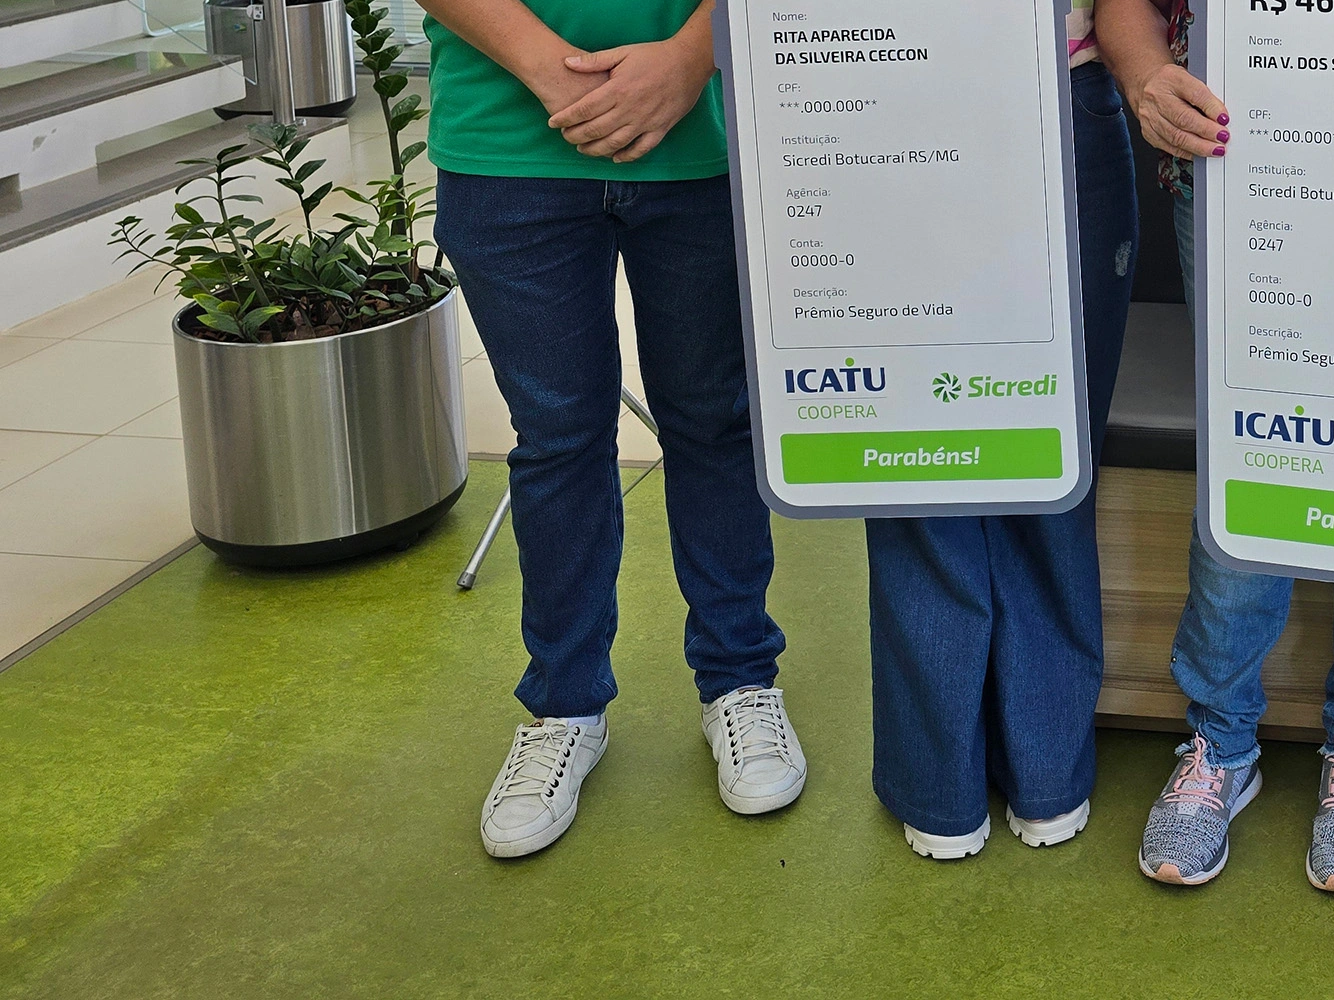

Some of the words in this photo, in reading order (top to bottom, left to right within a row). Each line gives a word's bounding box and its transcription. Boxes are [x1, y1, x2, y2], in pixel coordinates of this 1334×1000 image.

[772, 12, 807, 22] Nome:
[773, 31, 808, 44] RITA
[810, 28, 896, 43] APARECIDA
[1249, 35, 1282, 46] Nome:
[775, 52, 797, 65] DA
[799, 50, 866, 64] SILVEIRA
[869, 48, 928, 62] CECCON
[1248, 55, 1278, 69] IRIA
[1280, 56, 1294, 69] V.
[1297, 57, 1328, 71] DOS
[777, 83, 801, 93] CPF:
[1249, 109, 1271, 120] CPF:
[781, 134, 841, 146] Instituição:
[783, 153, 831, 167] Sicredi
[835, 151, 905, 166] Botucaraí
[908, 149, 960, 164] RS/MG
[1248, 164, 1306, 178] Instituição:
[786, 188, 831, 199] Agência:
[1248, 183, 1296, 199] Sicredi
[786, 204, 823, 218] 0247
[1249, 219, 1293, 231] Agência:
[789, 239, 824, 248] Conta:
[1249, 237, 1284, 251] 0247
[791, 253, 855, 268] 00000-0
[1249, 273, 1282, 284] Conta:
[793, 287, 848, 299] Descrição:
[1249, 290, 1312, 307] 00000-0
[794, 306, 845, 319] Prêmio
[848, 305, 898, 320] Seguro
[902, 304, 919, 316] de
[922, 303, 953, 316] Vida
[1249, 326, 1302, 340] Descrição:
[1249, 345, 1298, 362] Prêmio
[784, 357, 886, 394] ICATU
[967, 374, 1057, 398] Sicredi
[797, 404, 878, 420] COOPERA
[1234, 405, 1334, 446] ICATU
[863, 446, 980, 467] Parabéns!
[1244, 451, 1324, 475] COOPERA
